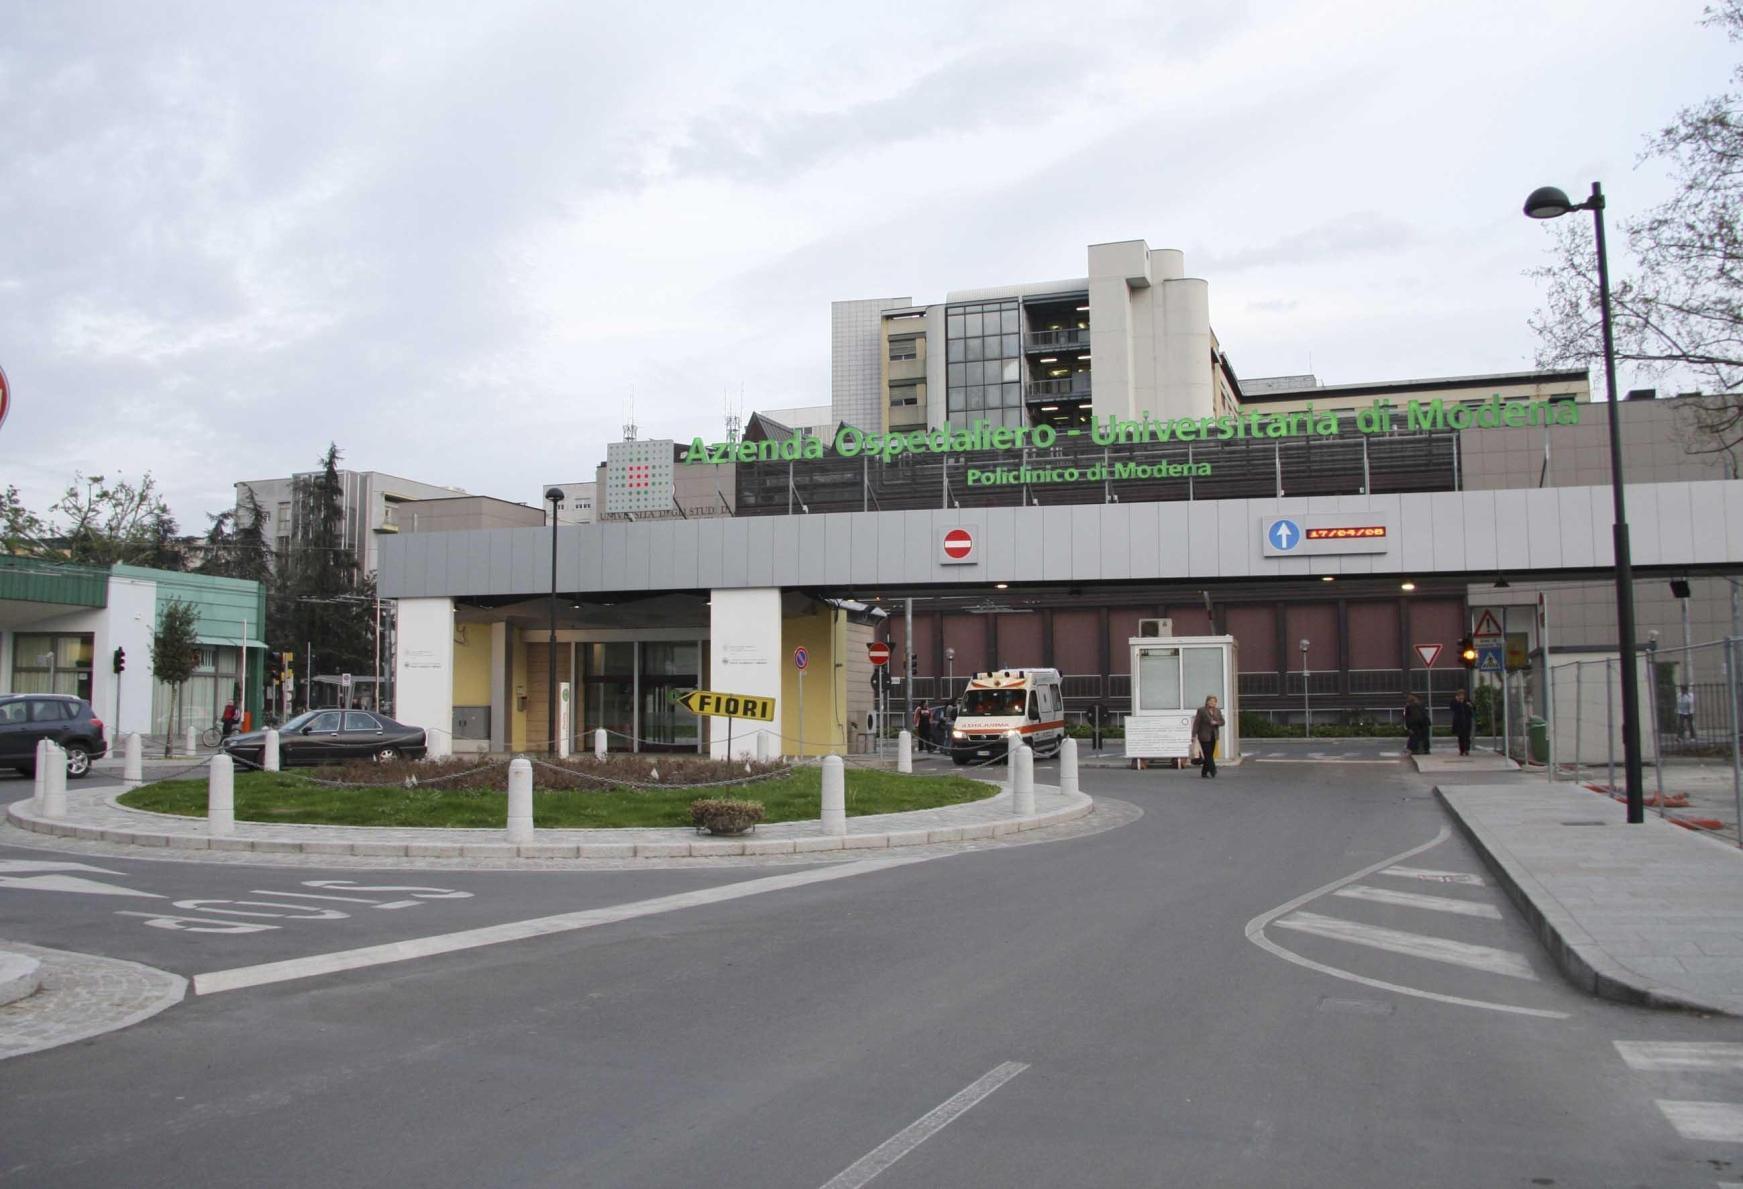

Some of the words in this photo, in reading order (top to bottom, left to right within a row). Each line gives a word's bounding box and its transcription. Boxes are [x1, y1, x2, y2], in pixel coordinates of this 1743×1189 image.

[685, 427, 823, 465] Azienda
[835, 418, 1057, 463] Ospedaliero
[1091, 401, 1339, 446] Universitaria
[1356, 398, 1391, 433] di
[1407, 393, 1580, 431] Modena
[967, 465, 1079, 486] Policlinico
[1087, 462, 1108, 481] di
[1114, 459, 1212, 479] Modena
[698, 695, 768, 718] FIORI
